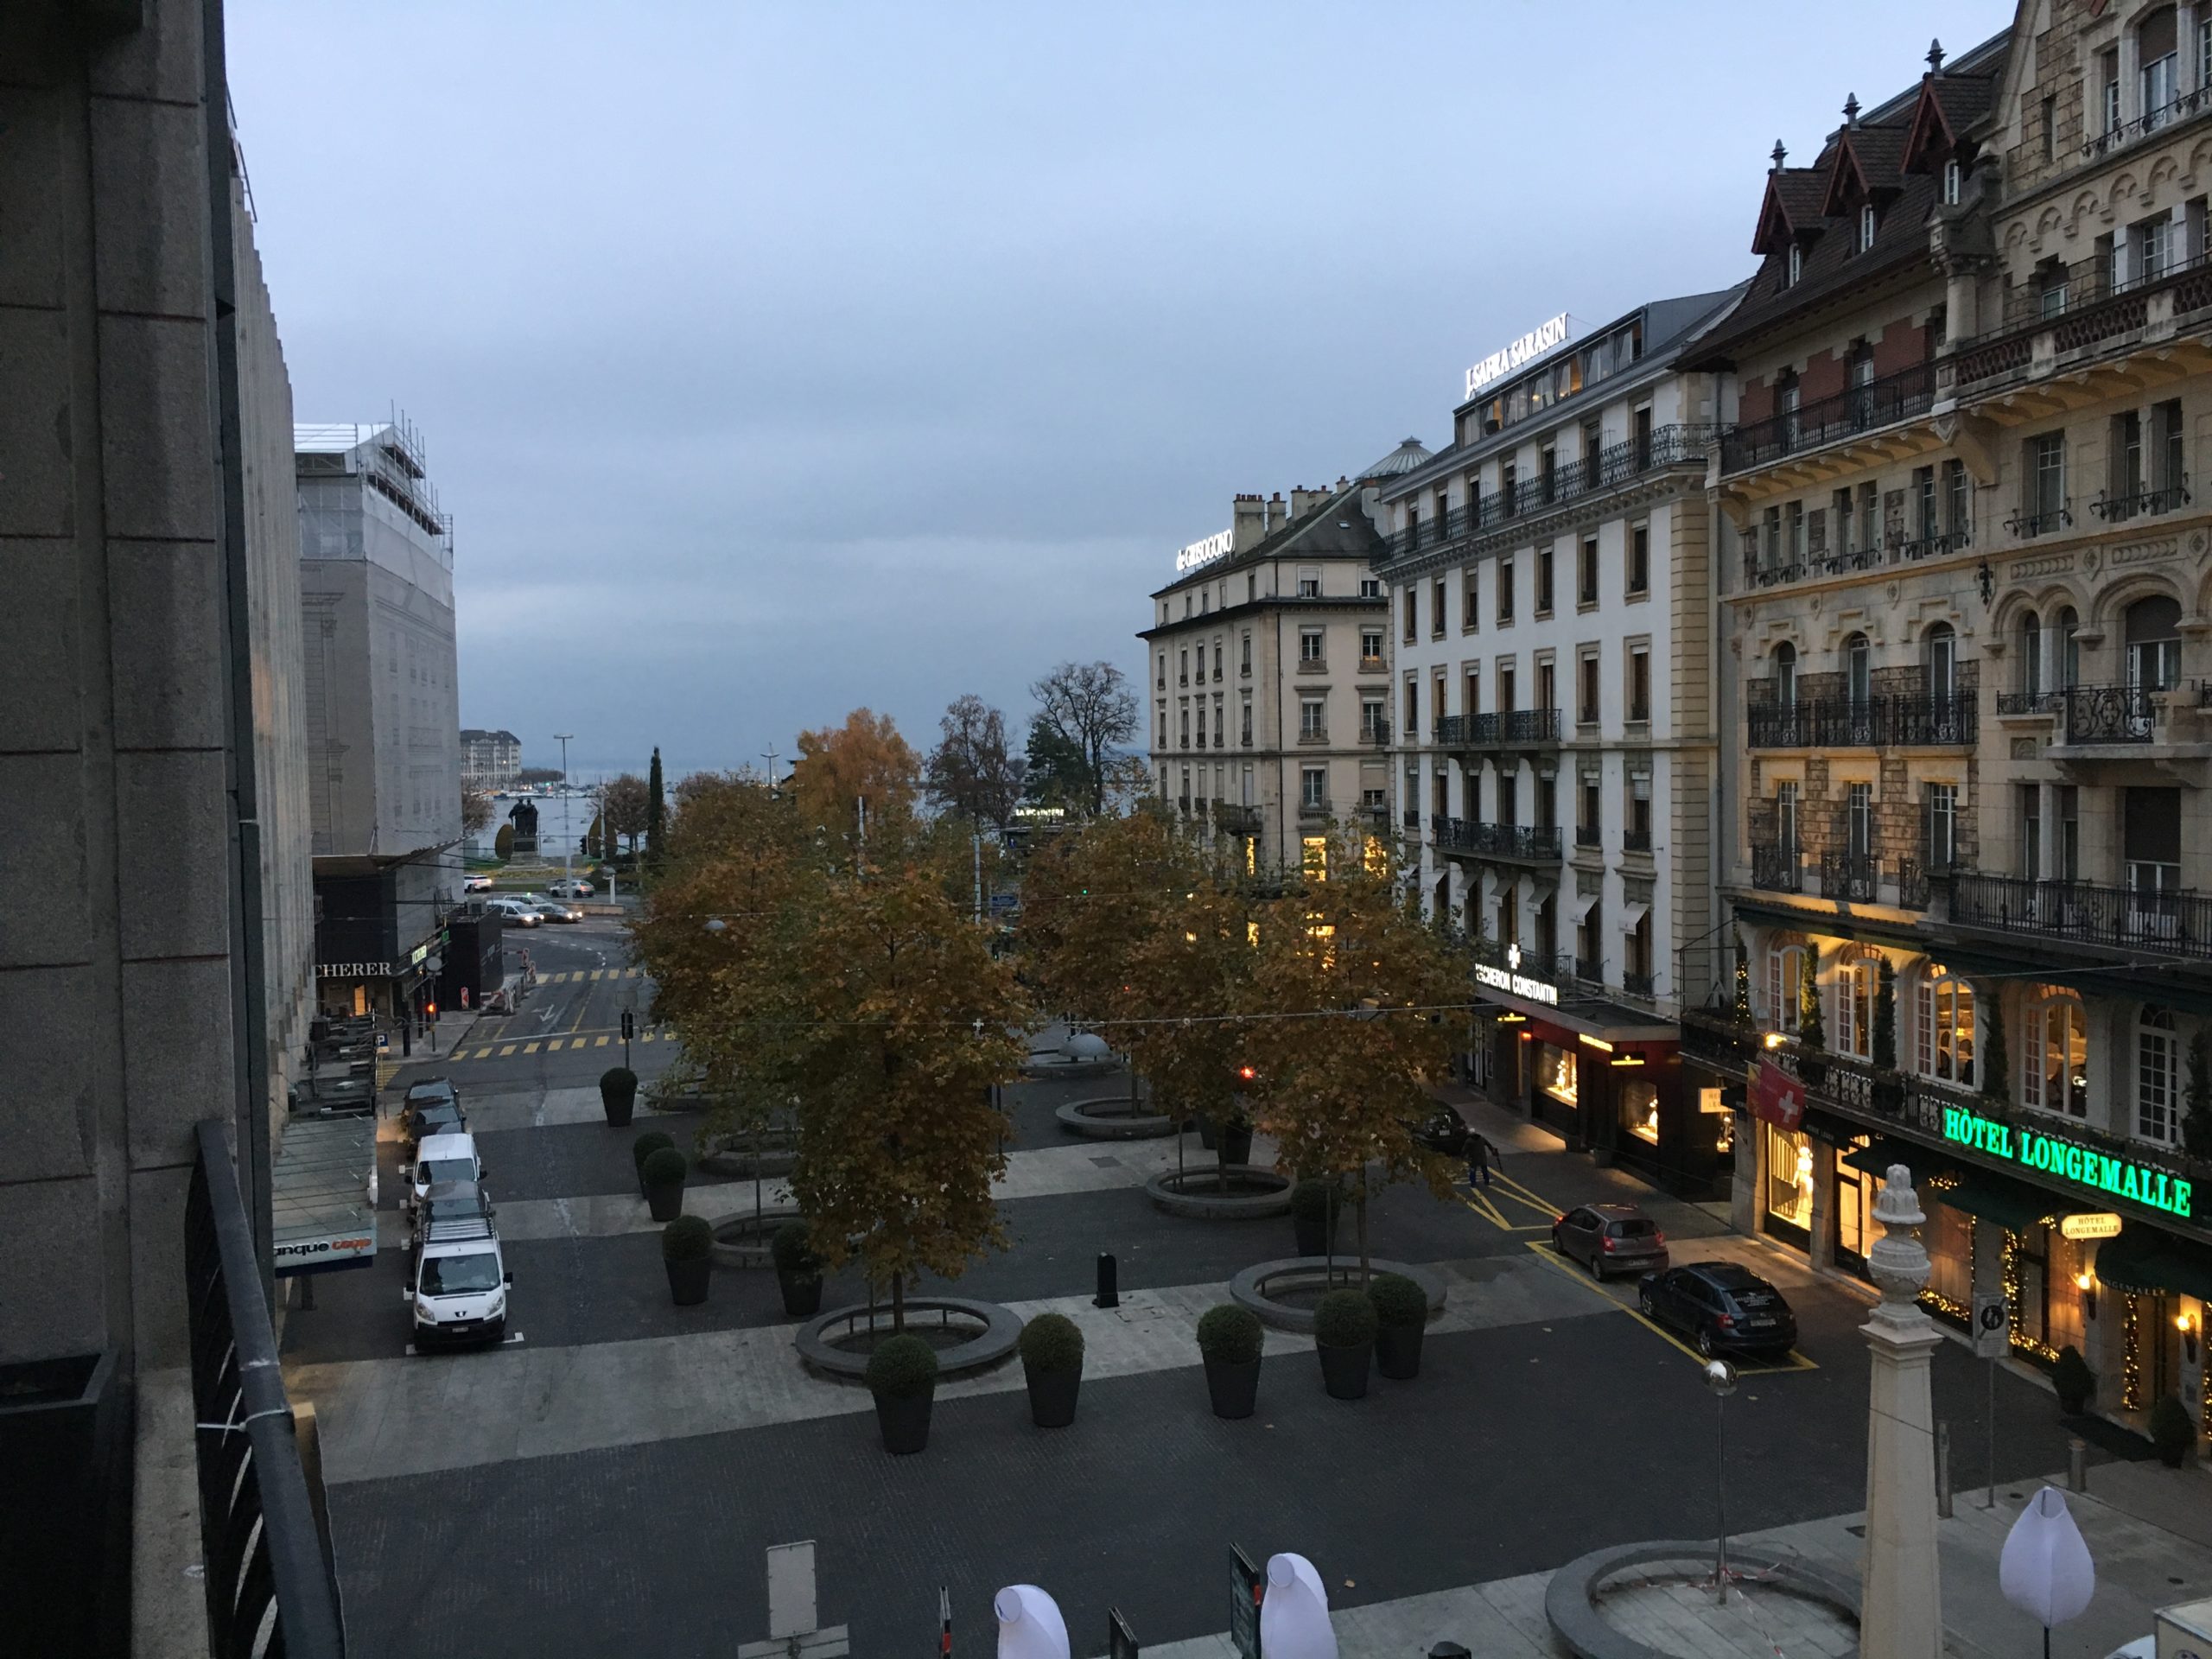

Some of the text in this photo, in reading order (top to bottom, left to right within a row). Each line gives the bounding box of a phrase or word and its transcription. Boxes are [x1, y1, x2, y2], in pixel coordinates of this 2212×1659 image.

[1510, 312, 1567, 368] SARASIN
[1512, 974, 1557, 1006] CONSTANTIN
[378, 1035, 385, 1046] P
[1945, 1108, 2191, 1217] HÔTEL LONGEMALLE
[2065, 1225, 2119, 1235] LONGEMALLE
